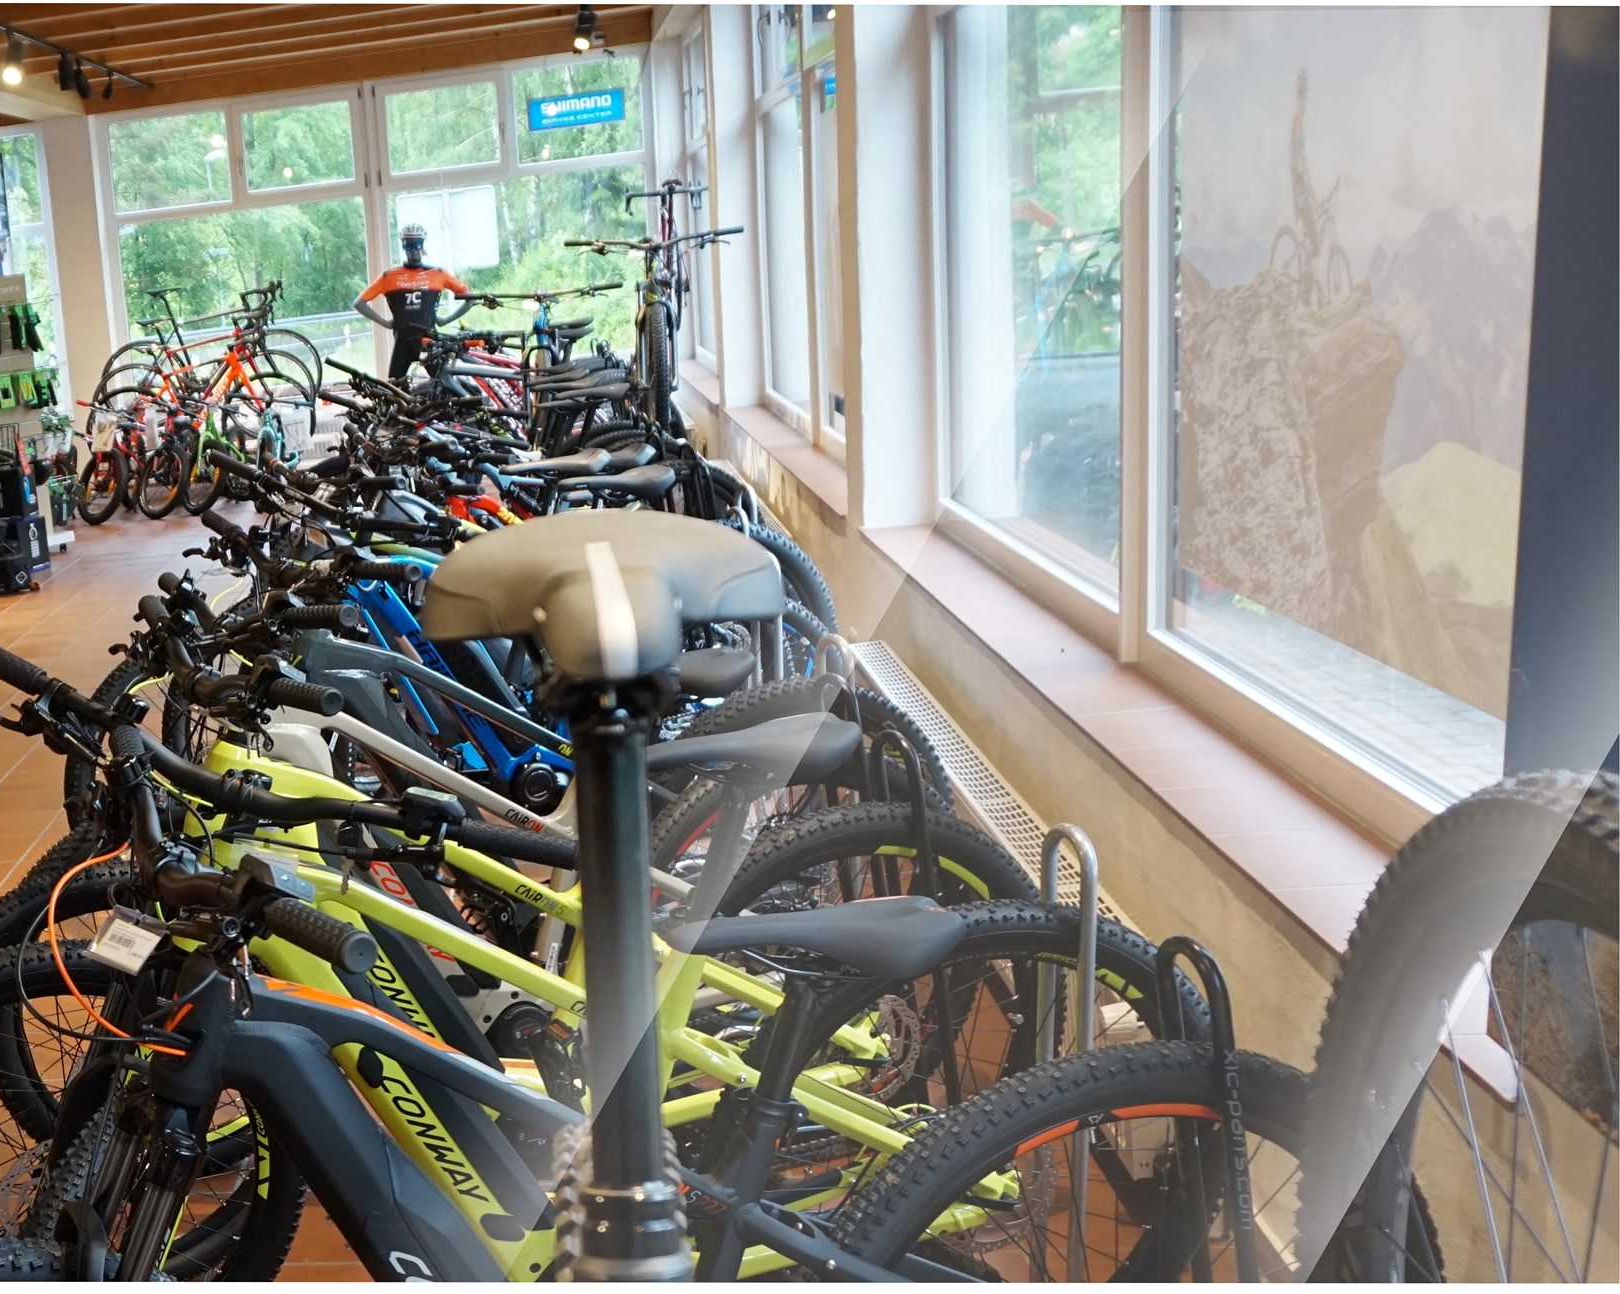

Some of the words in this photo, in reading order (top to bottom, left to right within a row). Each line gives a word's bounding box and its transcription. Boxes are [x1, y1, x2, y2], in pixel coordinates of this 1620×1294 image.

[576, 110, 613, 121] CENTER
[405, 291, 422, 305] 7C
[380, 1075, 490, 1203] CONWAY
